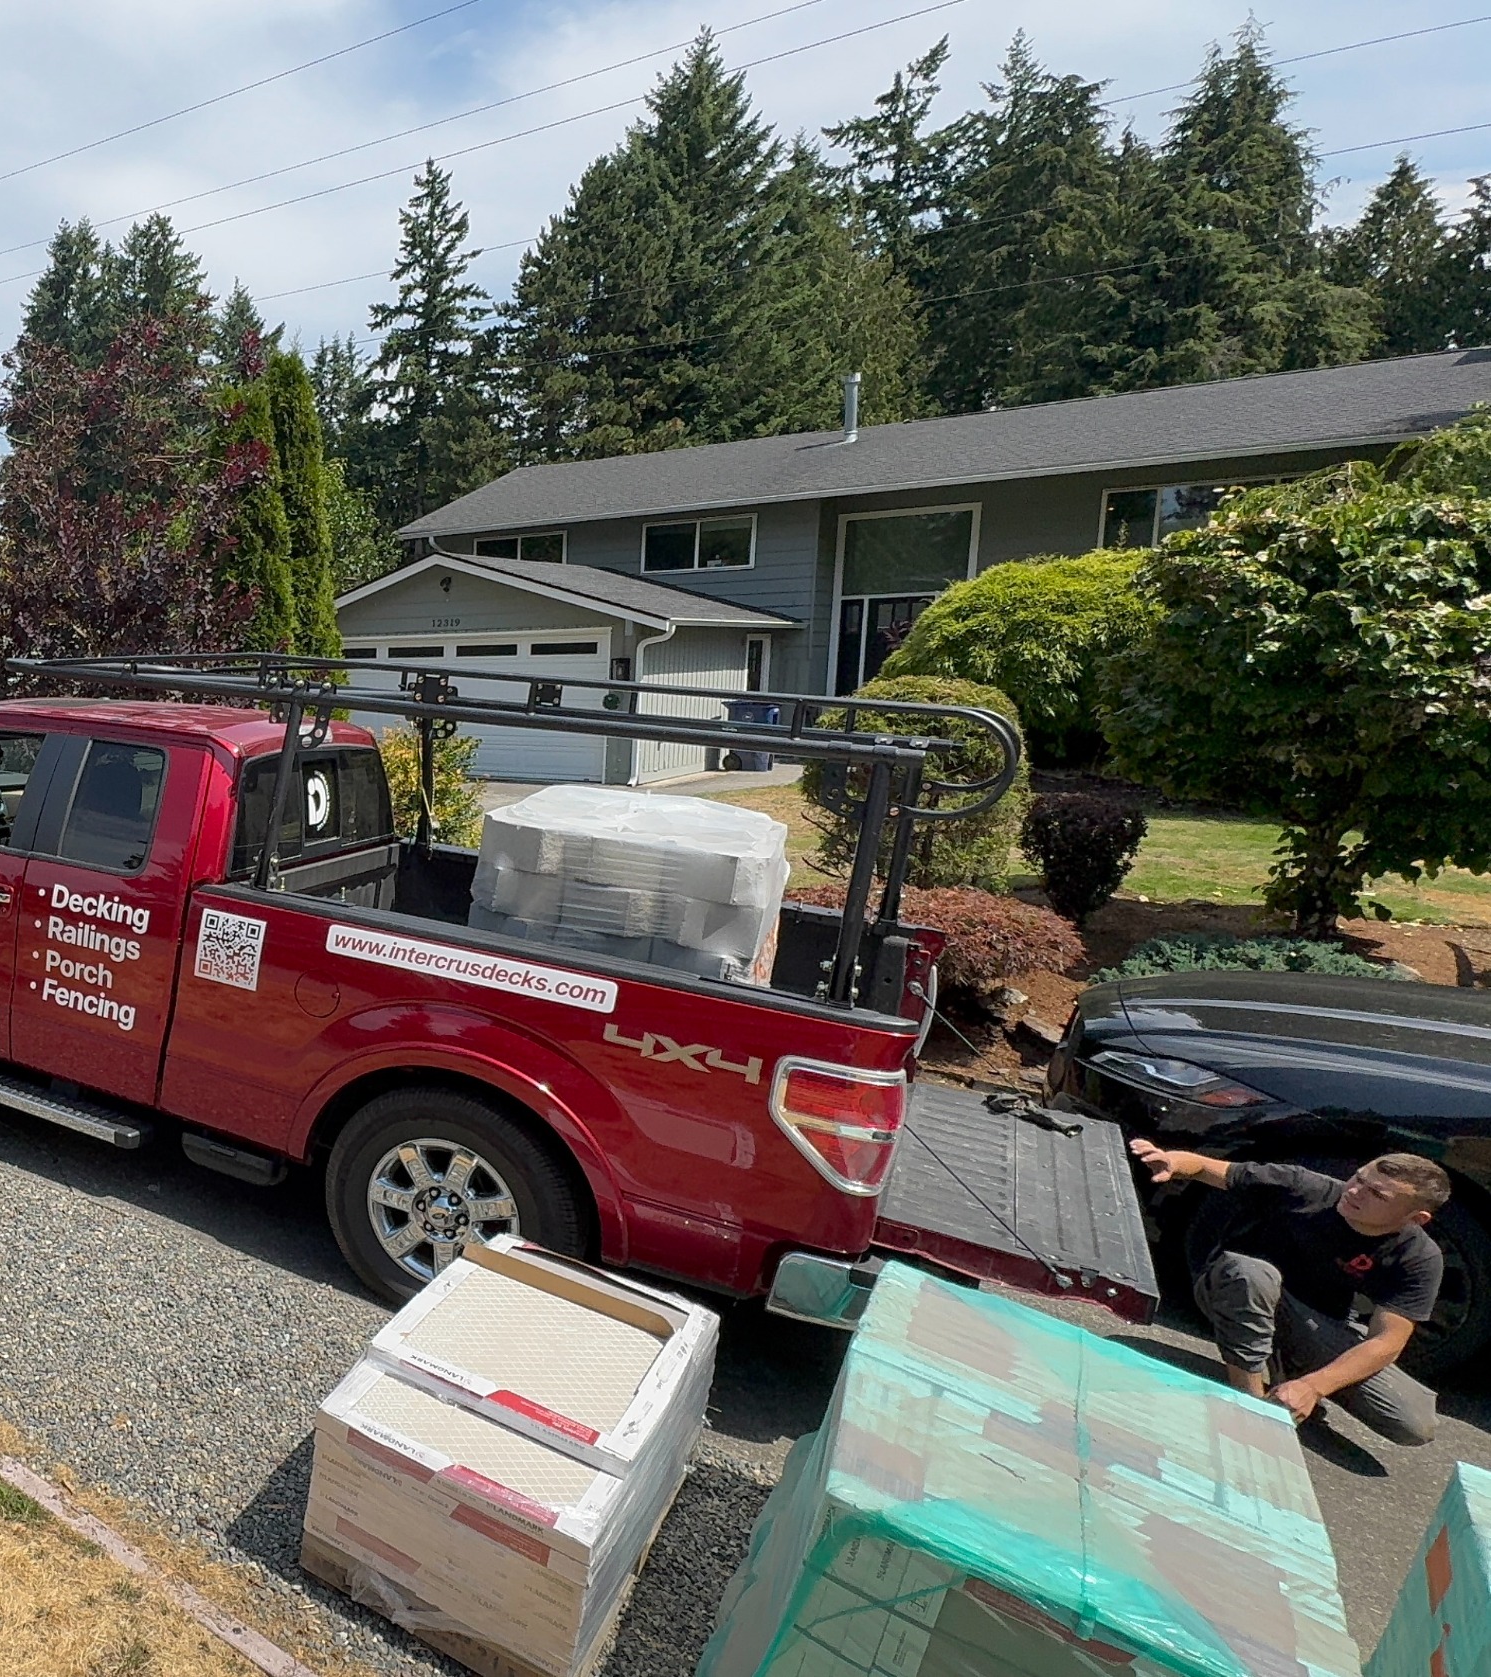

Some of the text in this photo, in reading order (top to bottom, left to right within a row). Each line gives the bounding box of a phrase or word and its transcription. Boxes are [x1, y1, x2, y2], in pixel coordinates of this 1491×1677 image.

[432, 618, 460, 627] 12319
[51, 884, 150, 934] Decking
[48, 916, 141, 963] Railings
[46, 949, 113, 989] Porch
[334, 932, 607, 1005] www.intercrusdecks.com
[42, 978, 136, 1031] Fencing
[410, 1354, 464, 1381] LANDMARK
[493, 1504, 544, 1535] LANDMARK
